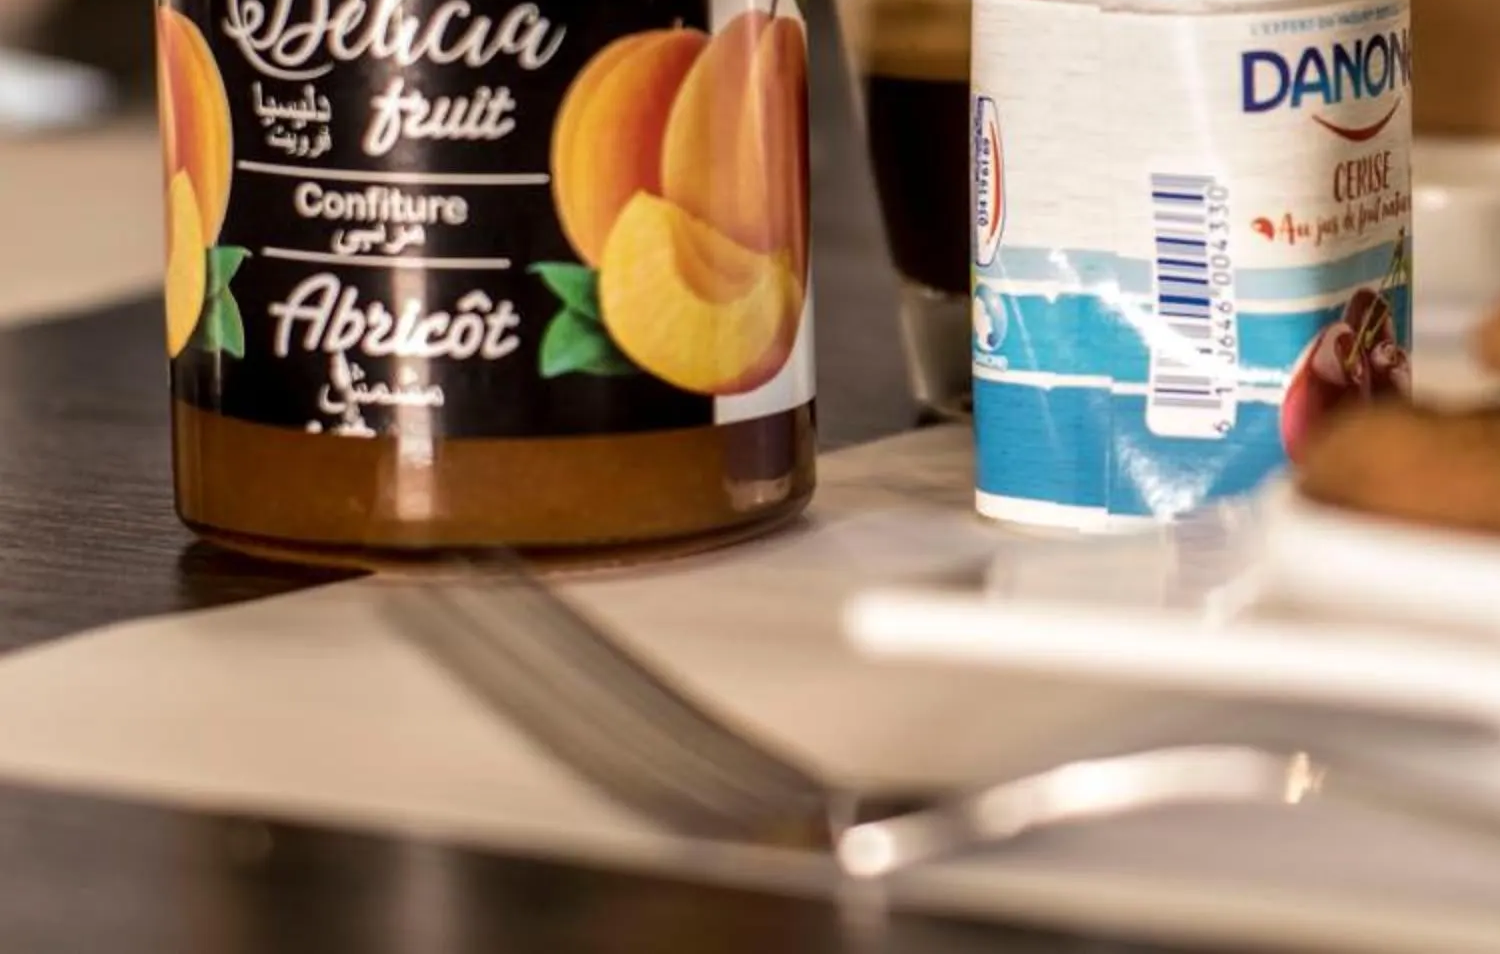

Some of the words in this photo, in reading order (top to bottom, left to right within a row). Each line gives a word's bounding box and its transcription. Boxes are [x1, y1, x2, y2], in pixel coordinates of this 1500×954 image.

[1241, 27, 1411, 113] DANON
[362, 77, 516, 156] fruit
[294, 181, 468, 225] Confiture
[1333, 151, 1393, 203] CERISE
[1280, 212, 1311, 245] Au
[267, 272, 520, 359] Abricôt
